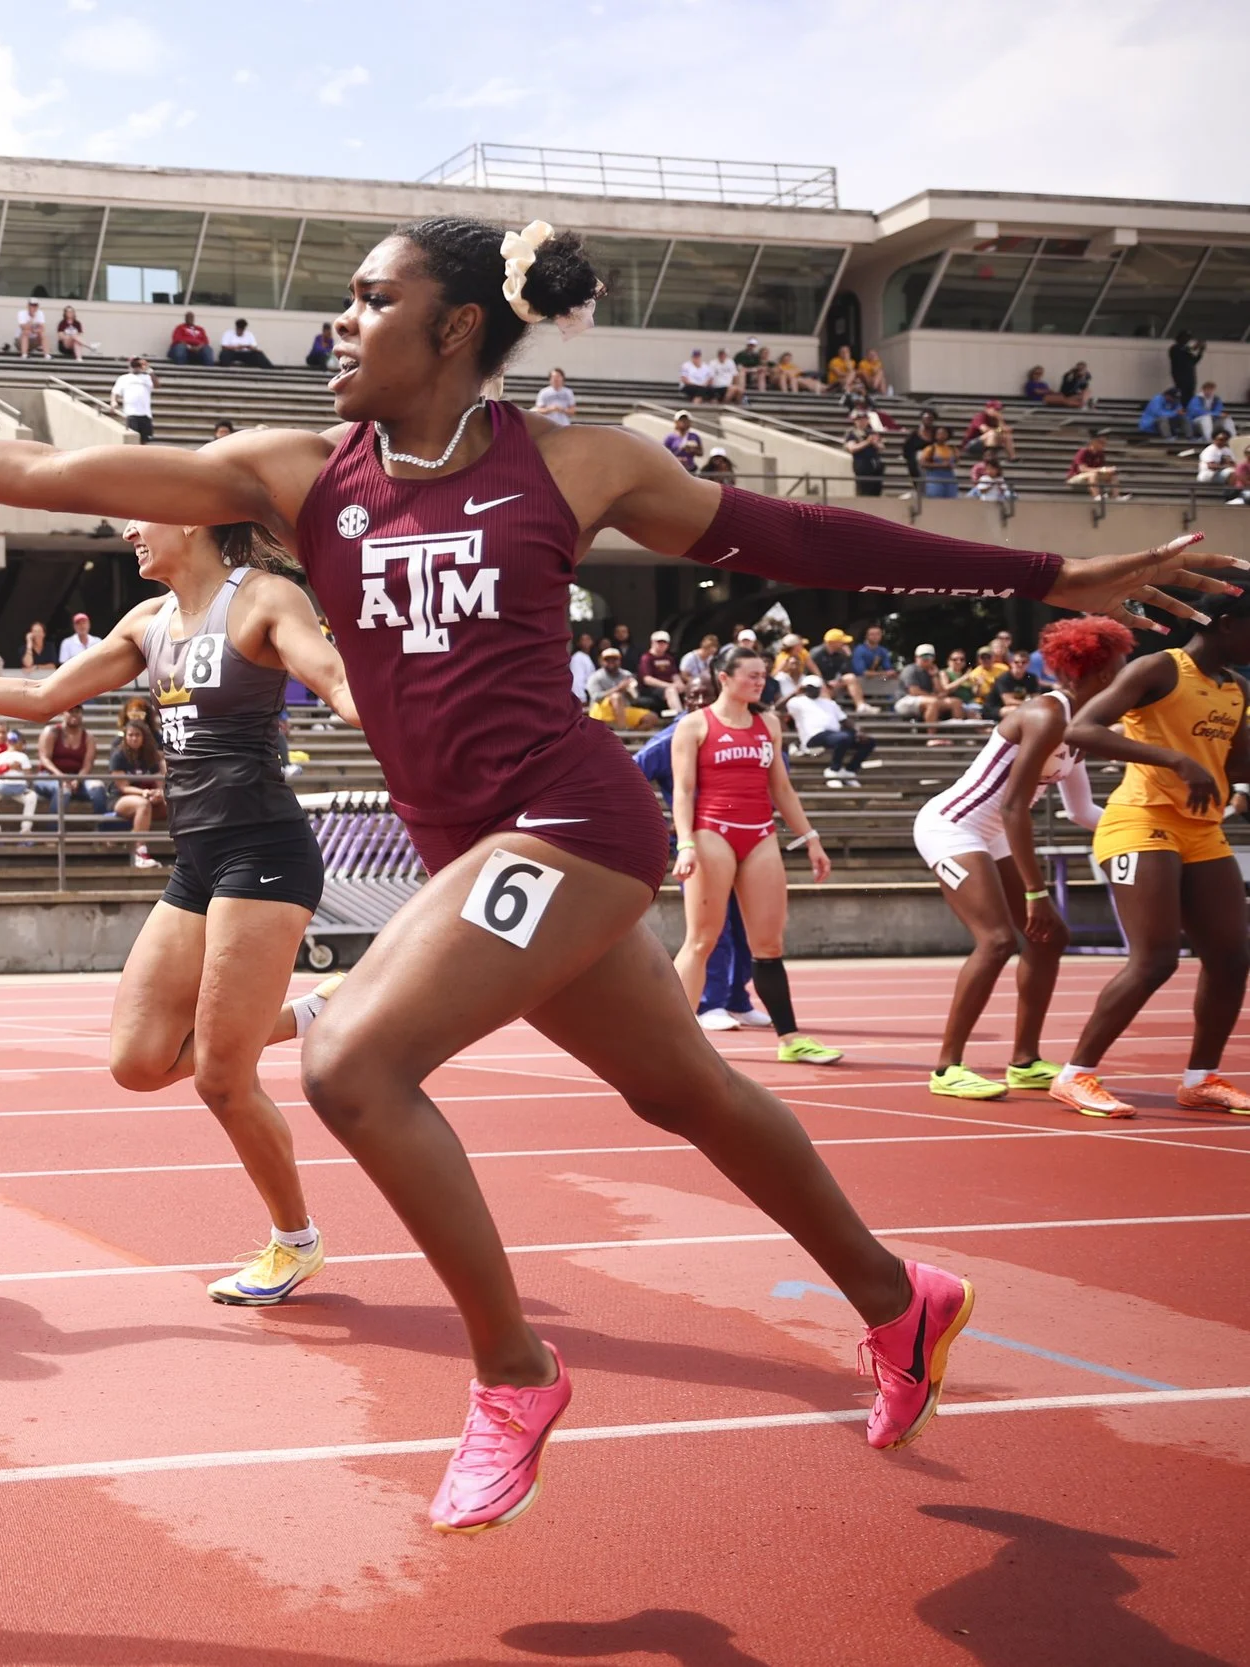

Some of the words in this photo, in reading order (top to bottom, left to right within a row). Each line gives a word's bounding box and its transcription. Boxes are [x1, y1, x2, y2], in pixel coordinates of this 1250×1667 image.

[338, 506, 368, 537] SEC
[192, 636, 215, 684] 8
[714, 745, 763, 765] INDIA
[942, 863, 960, 880] 1
[1117, 853, 1129, 880] 9
[484, 863, 544, 932] 6
